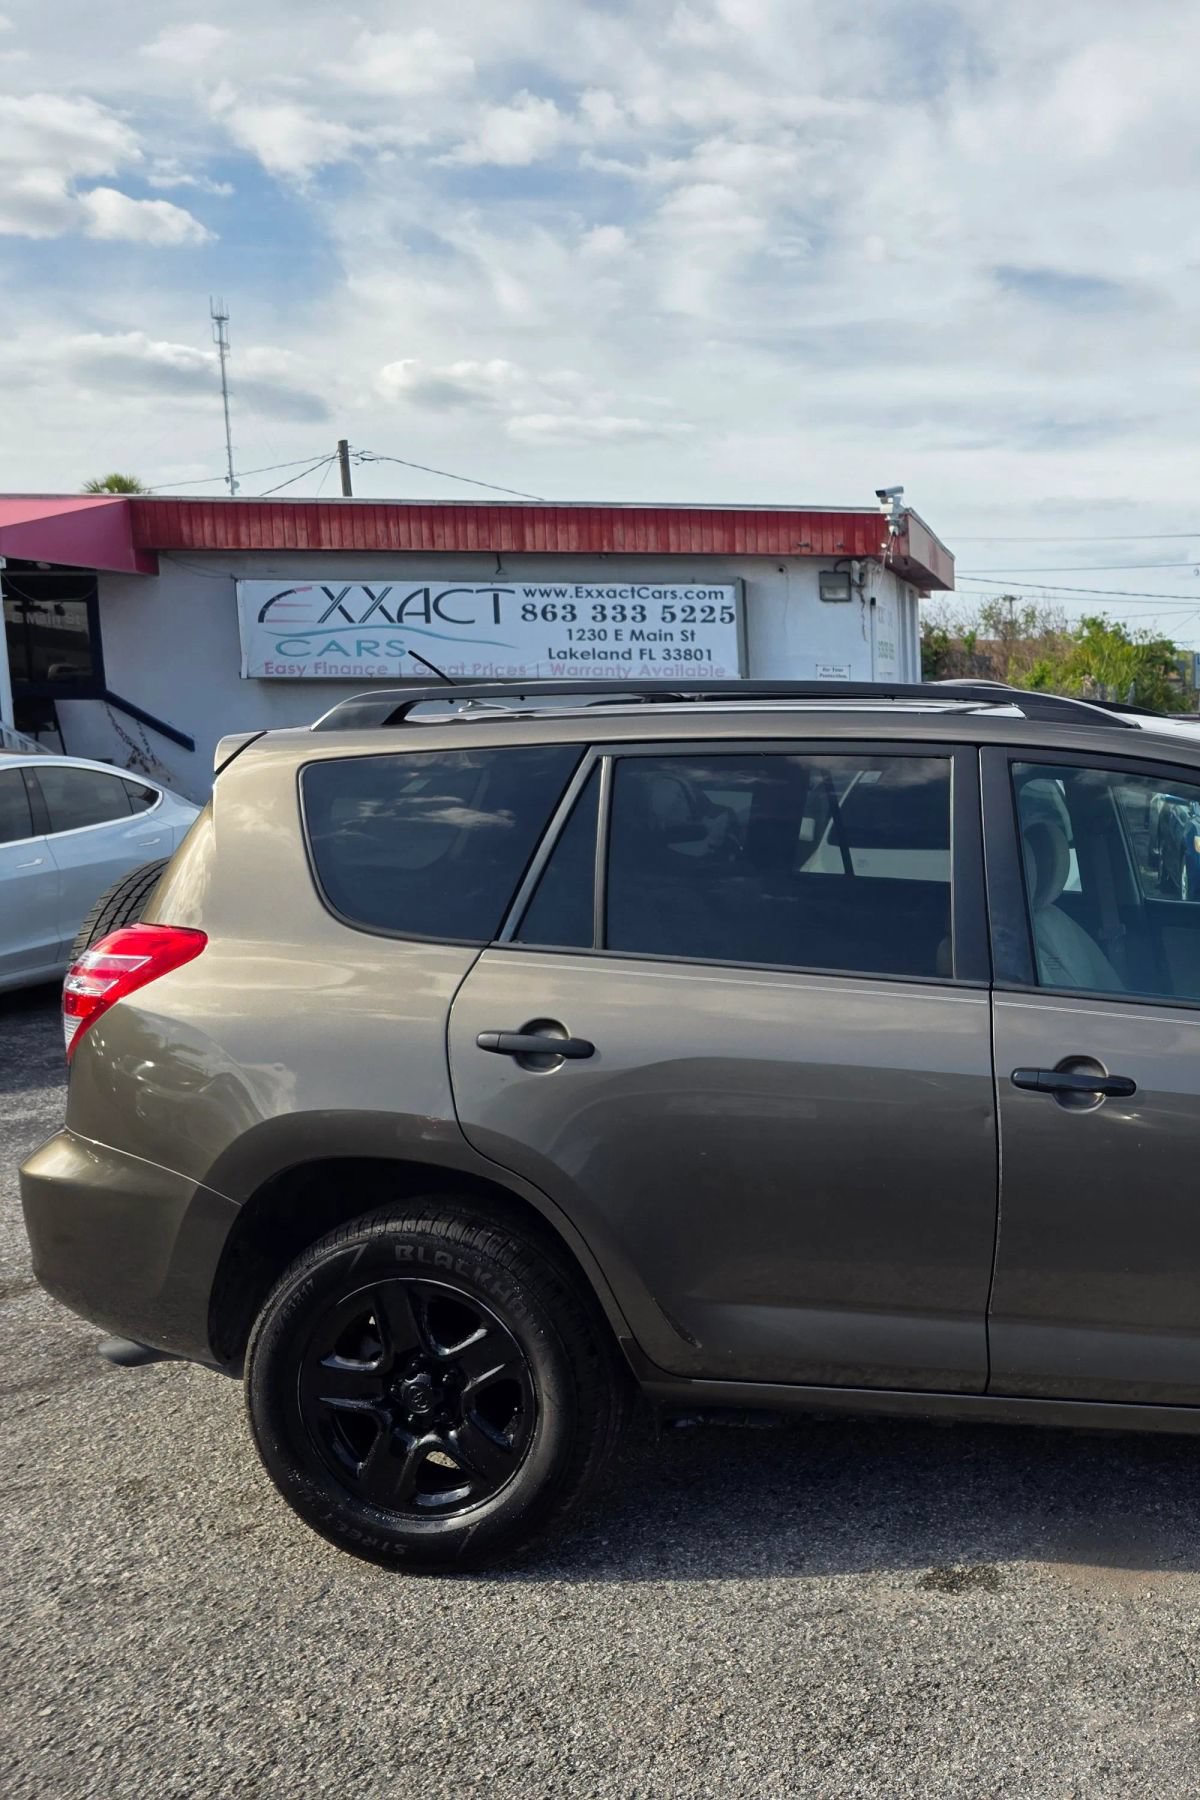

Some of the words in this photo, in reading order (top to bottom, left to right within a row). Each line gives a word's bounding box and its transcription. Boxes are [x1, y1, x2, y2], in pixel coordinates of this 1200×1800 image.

[522, 586, 724, 600] www.ExxactCars.com
[258, 586, 515, 625] EXXACT
[521, 603, 577, 622] 863
[591, 604, 647, 623] 333
[661, 605, 736, 624] 5225
[566, 629, 607, 641] 1230
[614, 631, 623, 641] E
[629, 629, 674, 642] Main
[680, 629, 696, 642] St
[275, 639, 407, 657] CARS
[548, 648, 632, 661] Lakeland
[640, 649, 656, 661] FL
[662, 649, 712, 661] 33801
[264, 662, 306, 677] Easy
[314, 661, 388, 675] Finance
[471, 662, 526, 676] Prices
[549, 662, 630, 678] Warranty
[639, 663, 726, 677] Available
[396, 1244, 540, 1336] BLACKHA
